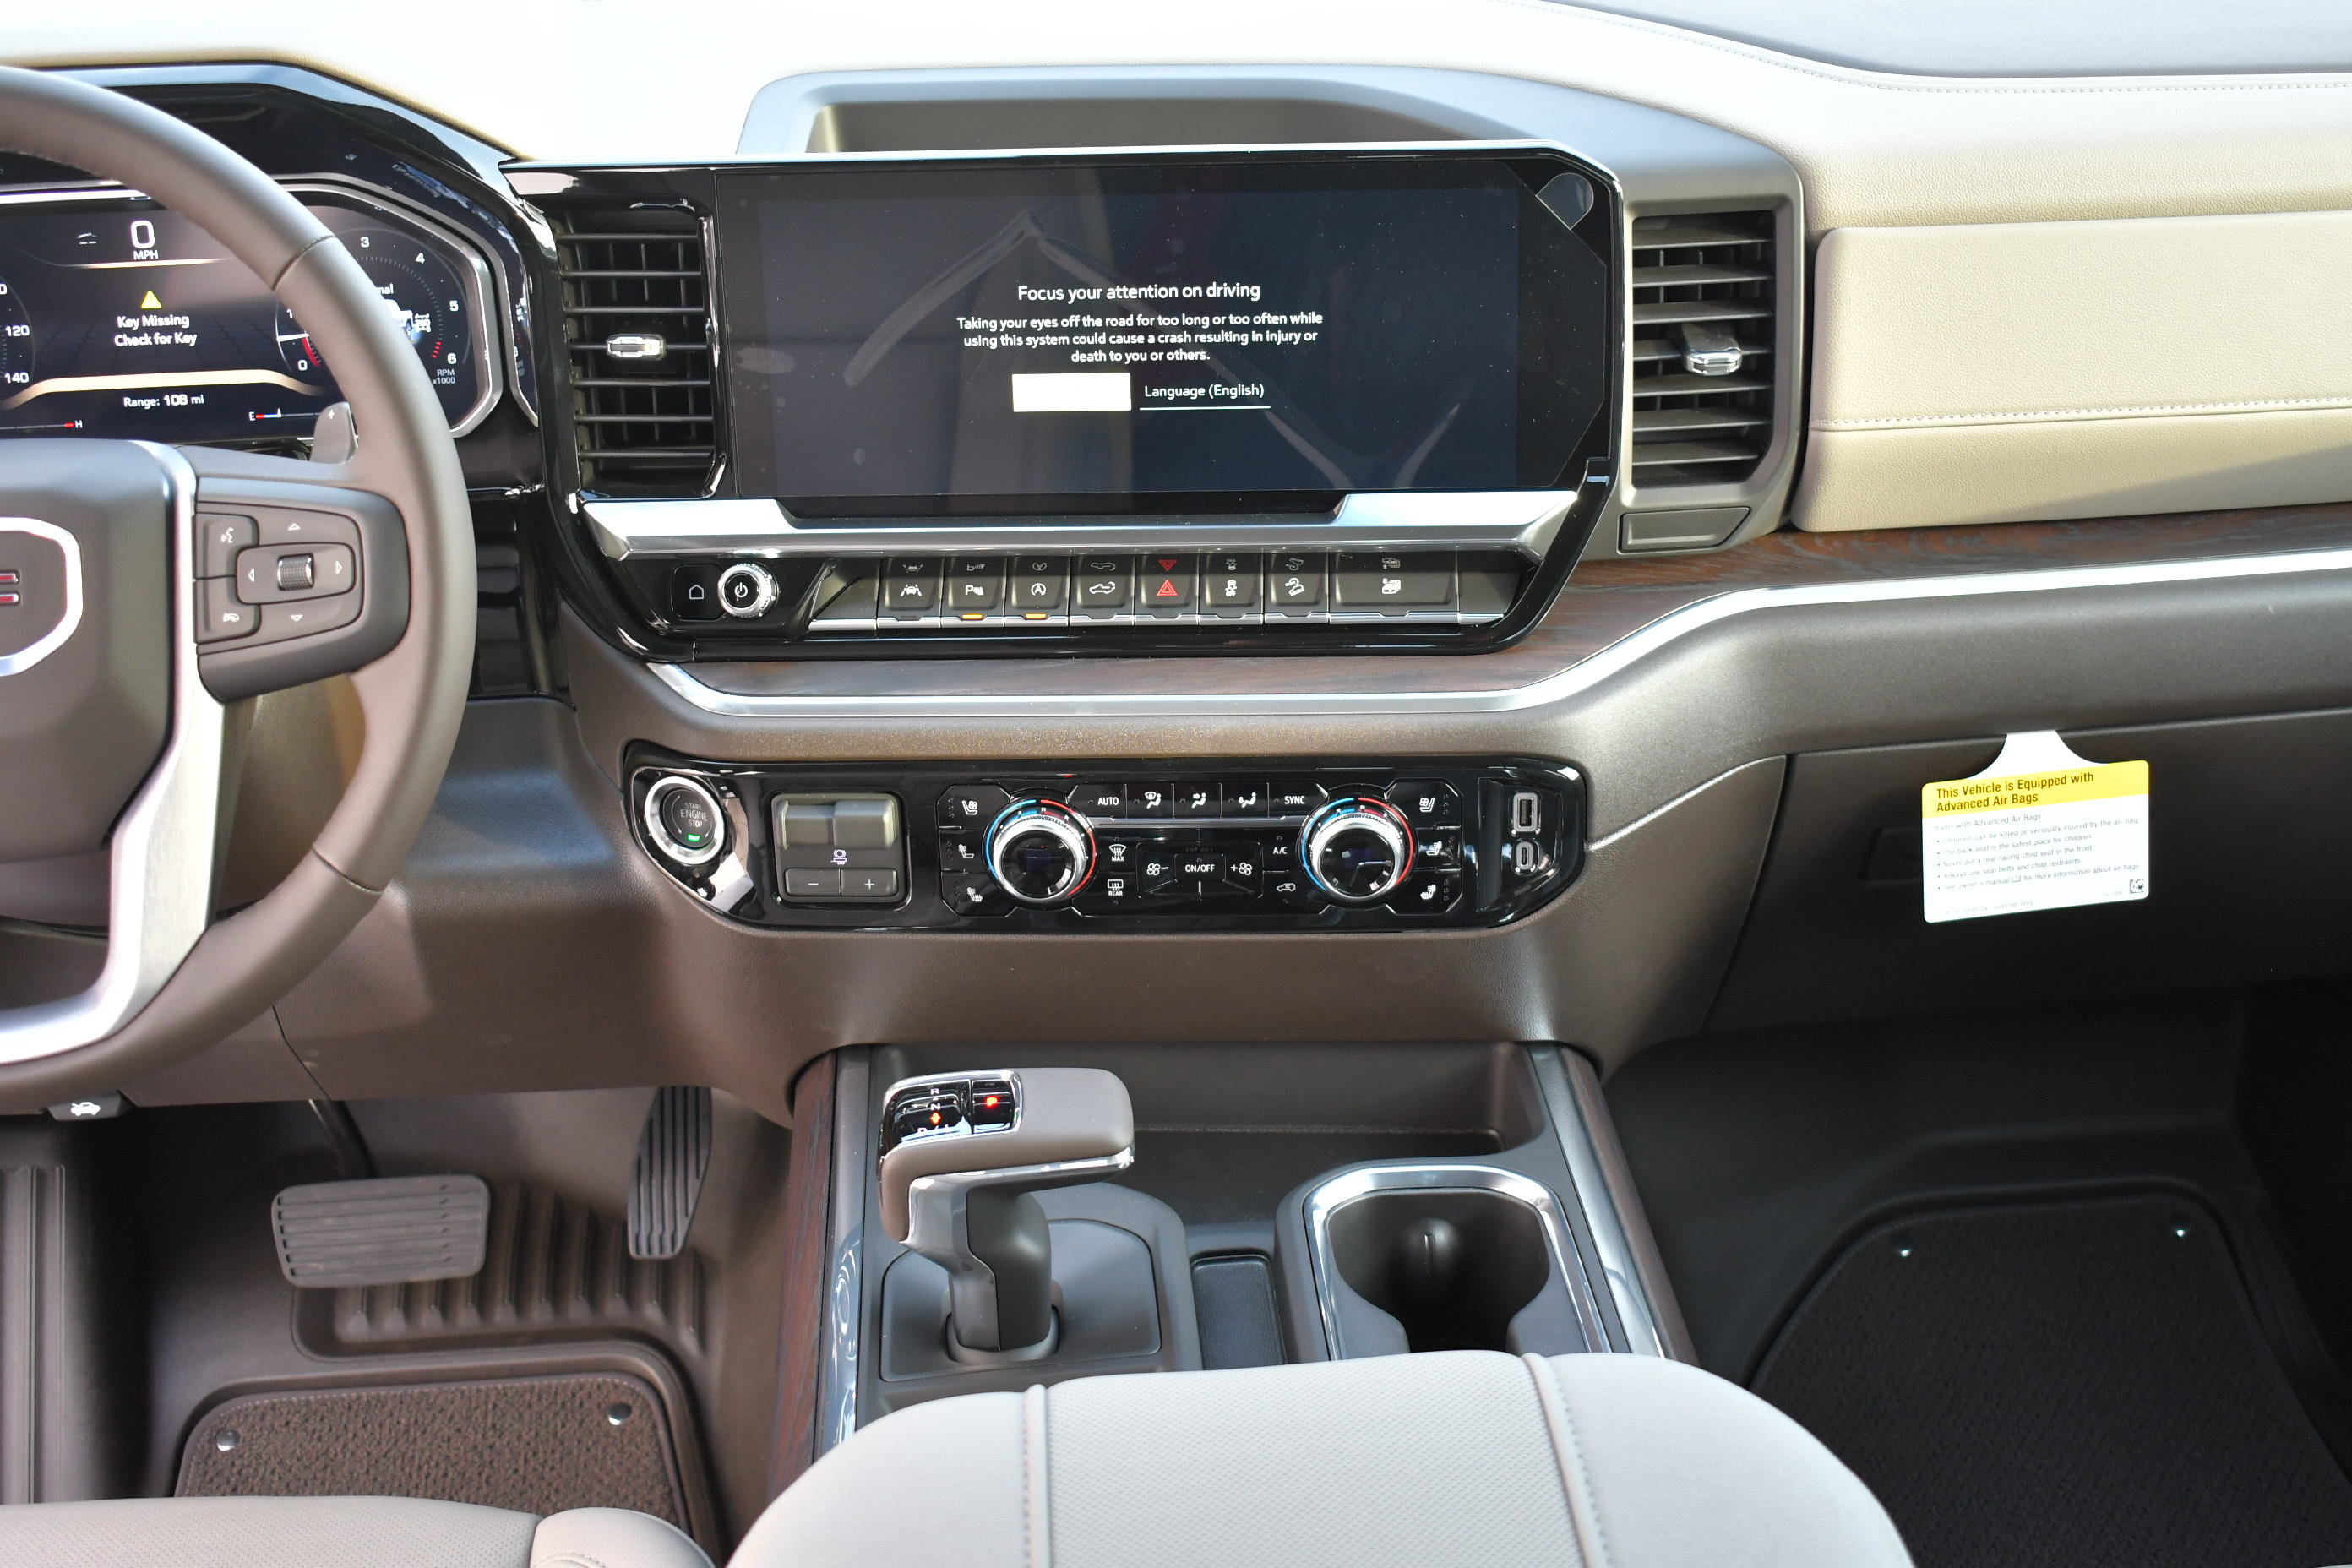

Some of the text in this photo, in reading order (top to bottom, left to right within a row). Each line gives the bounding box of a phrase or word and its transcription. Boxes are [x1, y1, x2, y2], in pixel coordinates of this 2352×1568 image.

[131, 220, 155, 249] 0
[360, 237, 370, 248] 3
[133, 249, 159, 260] MPH
[416, 253, 426, 264] 4
[1018, 282, 1260, 304] Focus your attention on driving
[449, 300, 459, 312] 5
[117, 315, 190, 330] Key Missing
[956, 311, 1323, 331] Taking your eyes off the road for too long or too often while
[5, 325, 30, 337] 120
[114, 332, 197, 346] Check for Key
[964, 329, 1318, 348] using this system could cause a crash resulting in injury or
[447, 352, 457, 364] 6
[1070, 347, 1211, 365] death to you or others.
[297, 359, 308, 372] 0
[4, 372, 30, 384] 140
[437, 368, 455, 377] RPM
[1144, 384, 1265, 400] Language (English)
[123, 396, 160, 410] Range:
[191, 395, 204, 405] mi
[248, 411, 256, 422] E
[75, 420, 83, 428] H
[1936, 772, 2094, 798] This Vehicle is Equipped with
[1097, 797, 1119, 806] AUTO
[1284, 795, 1305, 805] SYNC
[1936, 792, 2039, 813] Advanced Air Bags
[680, 808, 708, 822] ENGINE
[1974, 817, 2009, 826] Advanced
[2011, 814, 2021, 822] Air
[2023, 814, 2041, 822] Bags
[689, 819, 703, 828] STOP
[1272, 846, 1288, 855] A/C
[1185, 864, 1215, 873] ON/OFF
